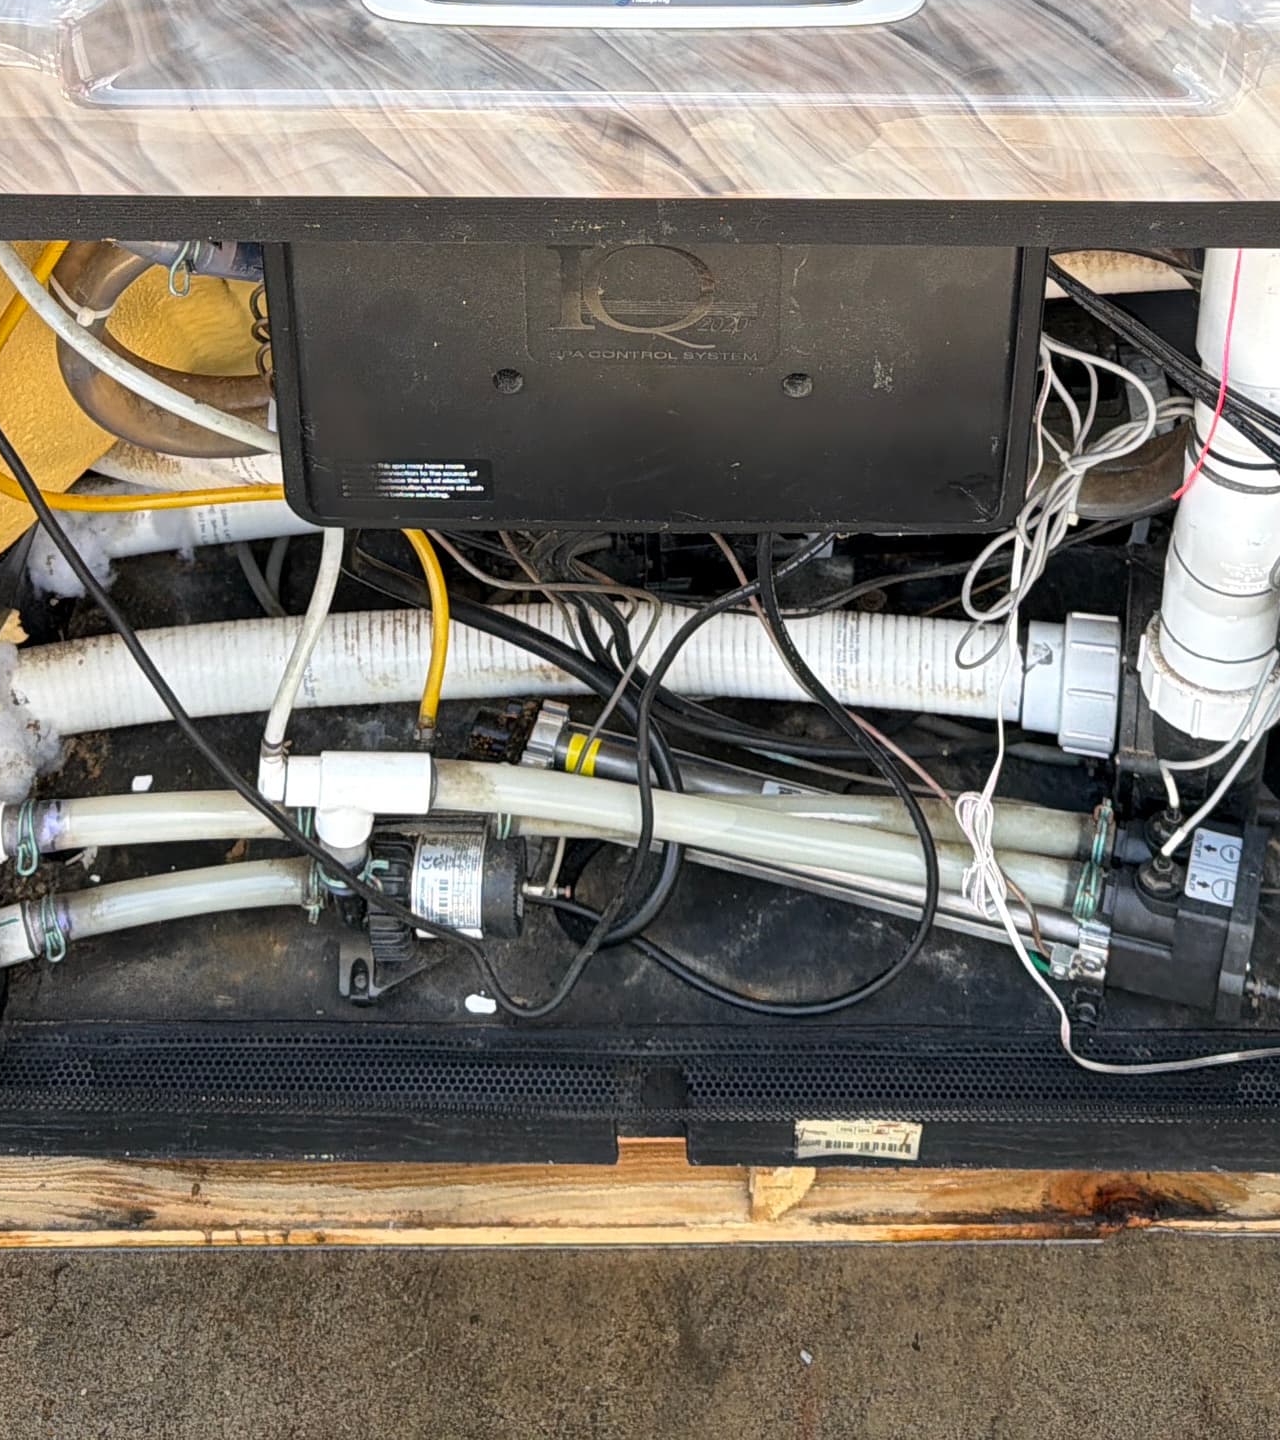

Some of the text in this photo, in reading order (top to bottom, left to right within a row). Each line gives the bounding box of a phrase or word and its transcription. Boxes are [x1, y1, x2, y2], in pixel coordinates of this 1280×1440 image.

[549, 350, 759, 361] SPA CONTROL SYSTEM
